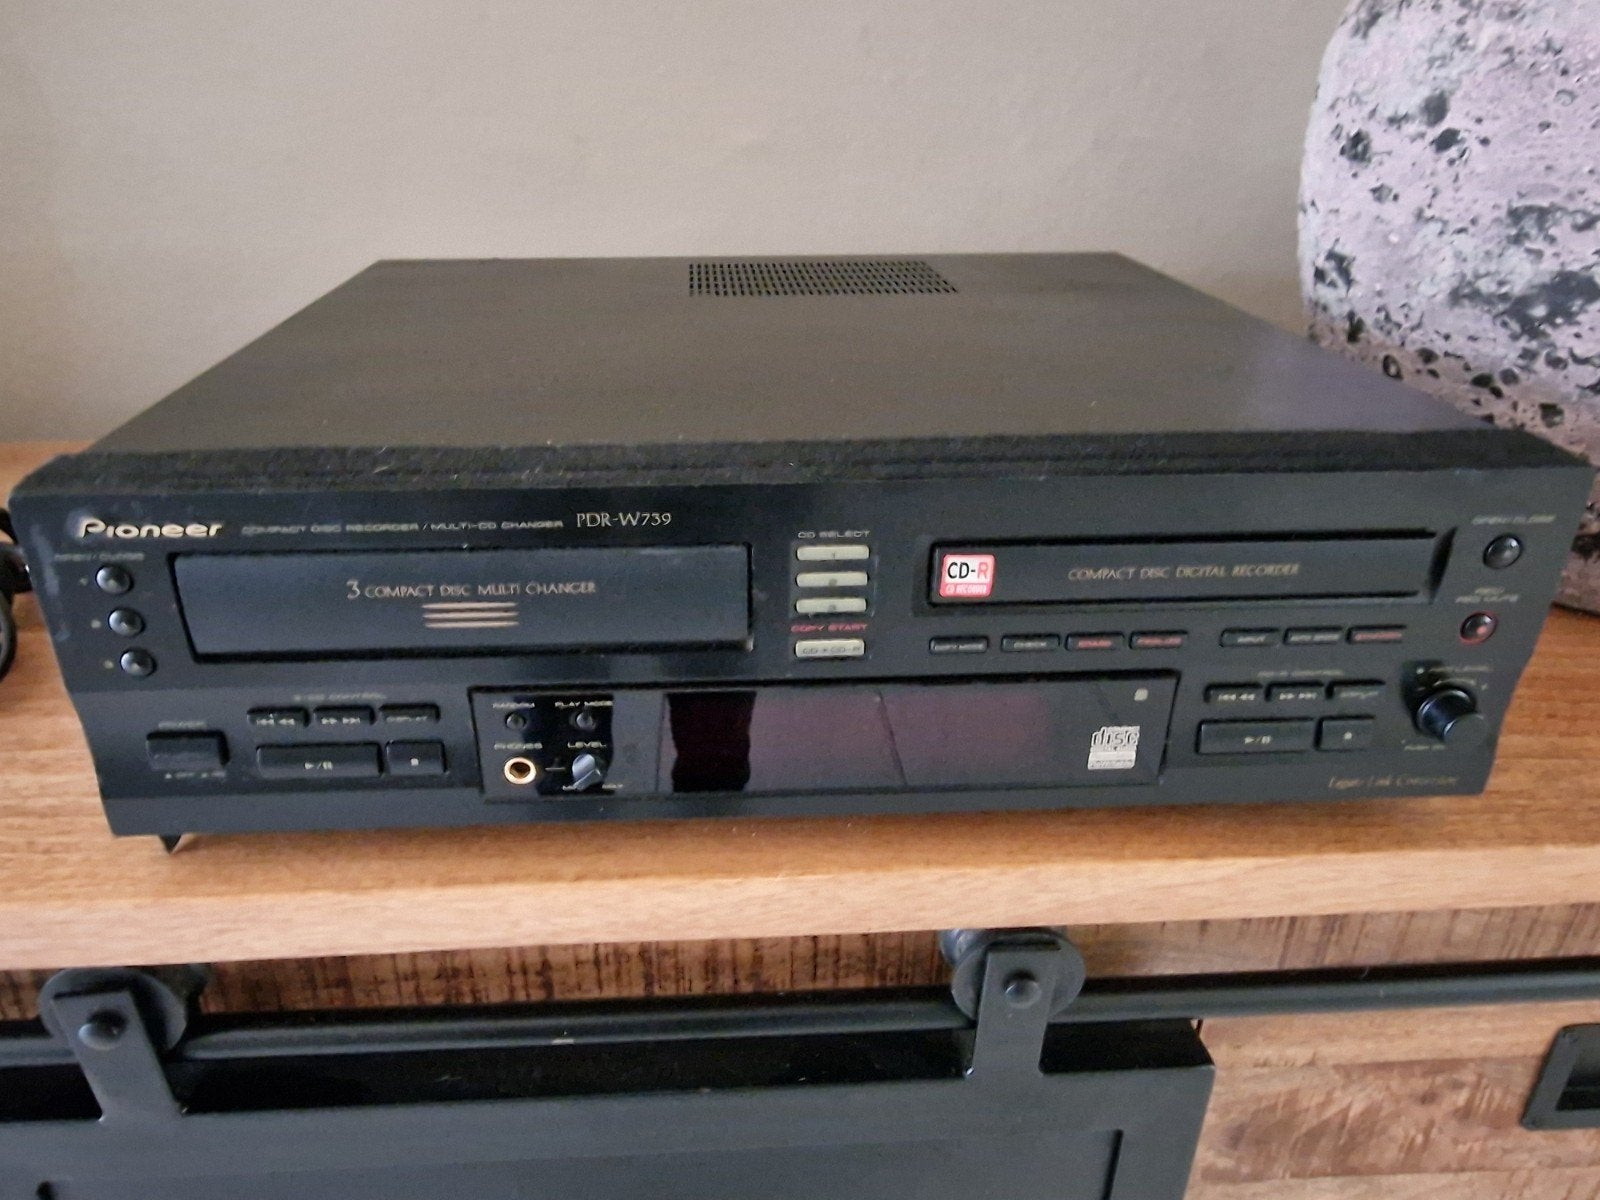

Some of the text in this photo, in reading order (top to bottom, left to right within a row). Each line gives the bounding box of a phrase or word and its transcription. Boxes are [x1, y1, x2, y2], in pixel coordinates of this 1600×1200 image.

[79, 517, 224, 538] Pioneer
[576, 512, 672, 528] PDR-W739
[947, 561, 989, 579] CD-R
[346, 579, 361, 599] 3
[365, 585, 434, 598] COMPACT
[440, 585, 470, 597] DISC
[525, 581, 596, 595] CHANGER
